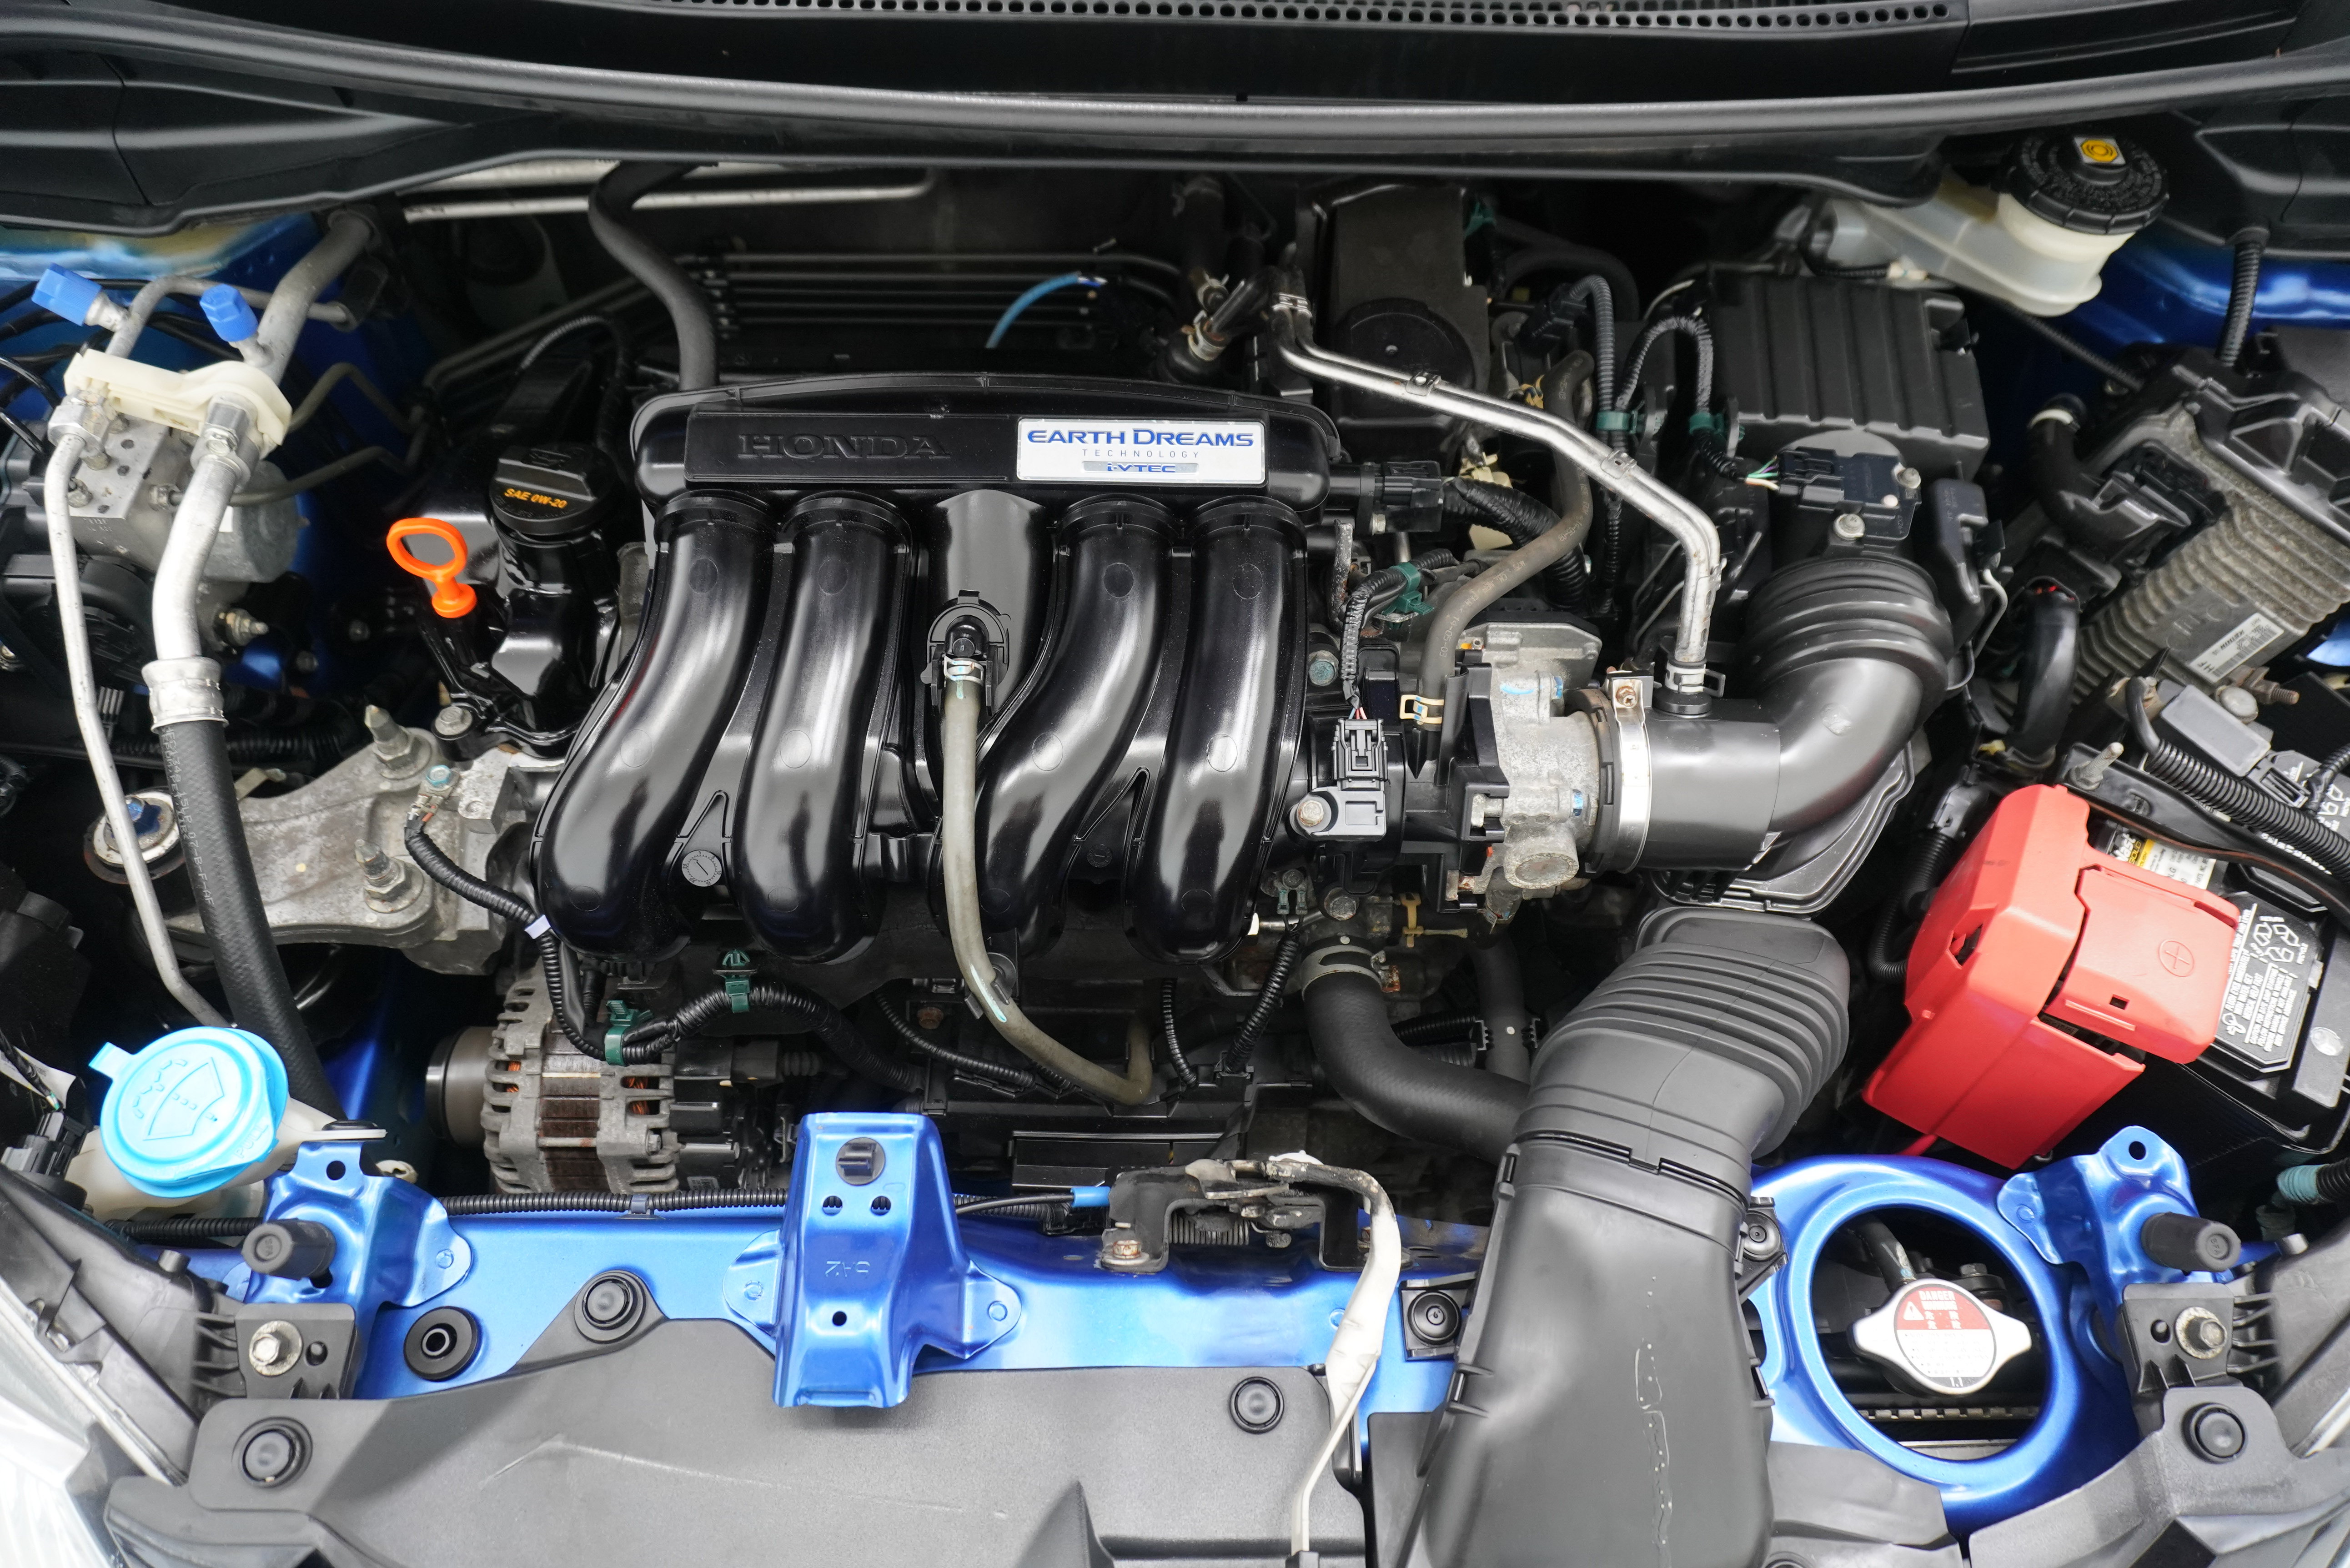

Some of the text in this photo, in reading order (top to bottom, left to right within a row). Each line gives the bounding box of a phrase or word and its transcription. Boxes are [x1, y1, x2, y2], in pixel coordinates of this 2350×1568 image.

[1027, 428, 1254, 447] EARTH DREAMS
[738, 434, 951, 459] HONDA
[1082, 449, 1199, 458] TECHNOLOGY
[1106, 462, 1176, 473] i-VTEC
[504, 488, 532, 501] SAE
[531, 494, 568, 509] 0W-20
[2252, 972, 2264, 987] FAST
[233, 1124, 269, 1159] PULL
[1918, 1290, 1956, 1301] DANGER
[1949, 1377, 1963, 1387] 1.1
